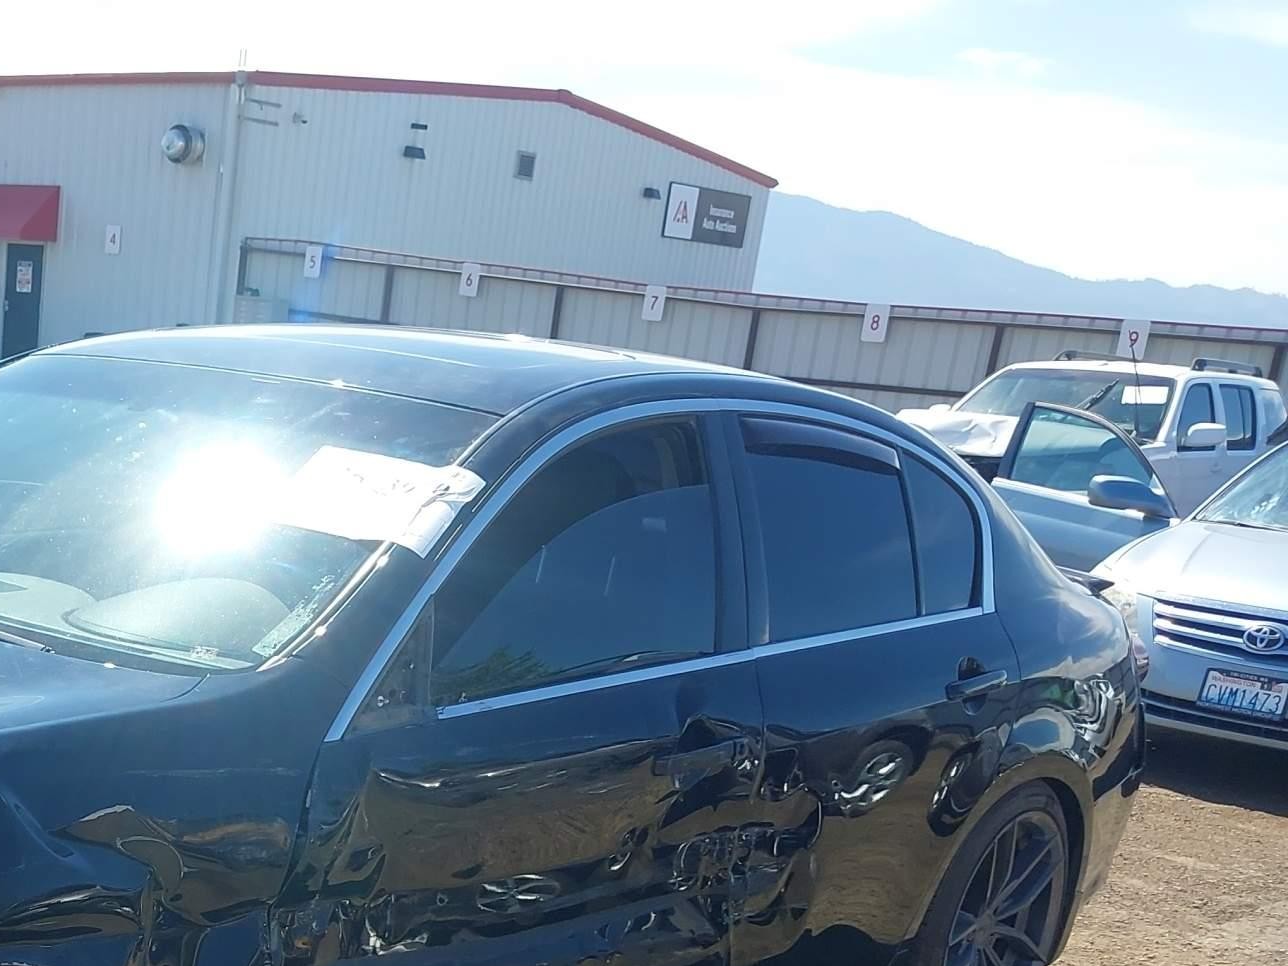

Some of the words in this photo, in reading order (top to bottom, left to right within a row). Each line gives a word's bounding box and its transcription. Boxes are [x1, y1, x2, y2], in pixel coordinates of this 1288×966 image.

[110, 232, 117, 246] 4
[309, 255, 317, 269] 5
[465, 273, 473, 287] 6
[650, 295, 659, 311] 7
[870, 314, 880, 331] 8
[1128, 330, 1139, 348] 9
[1205, 683, 1282, 713] CVM1473
